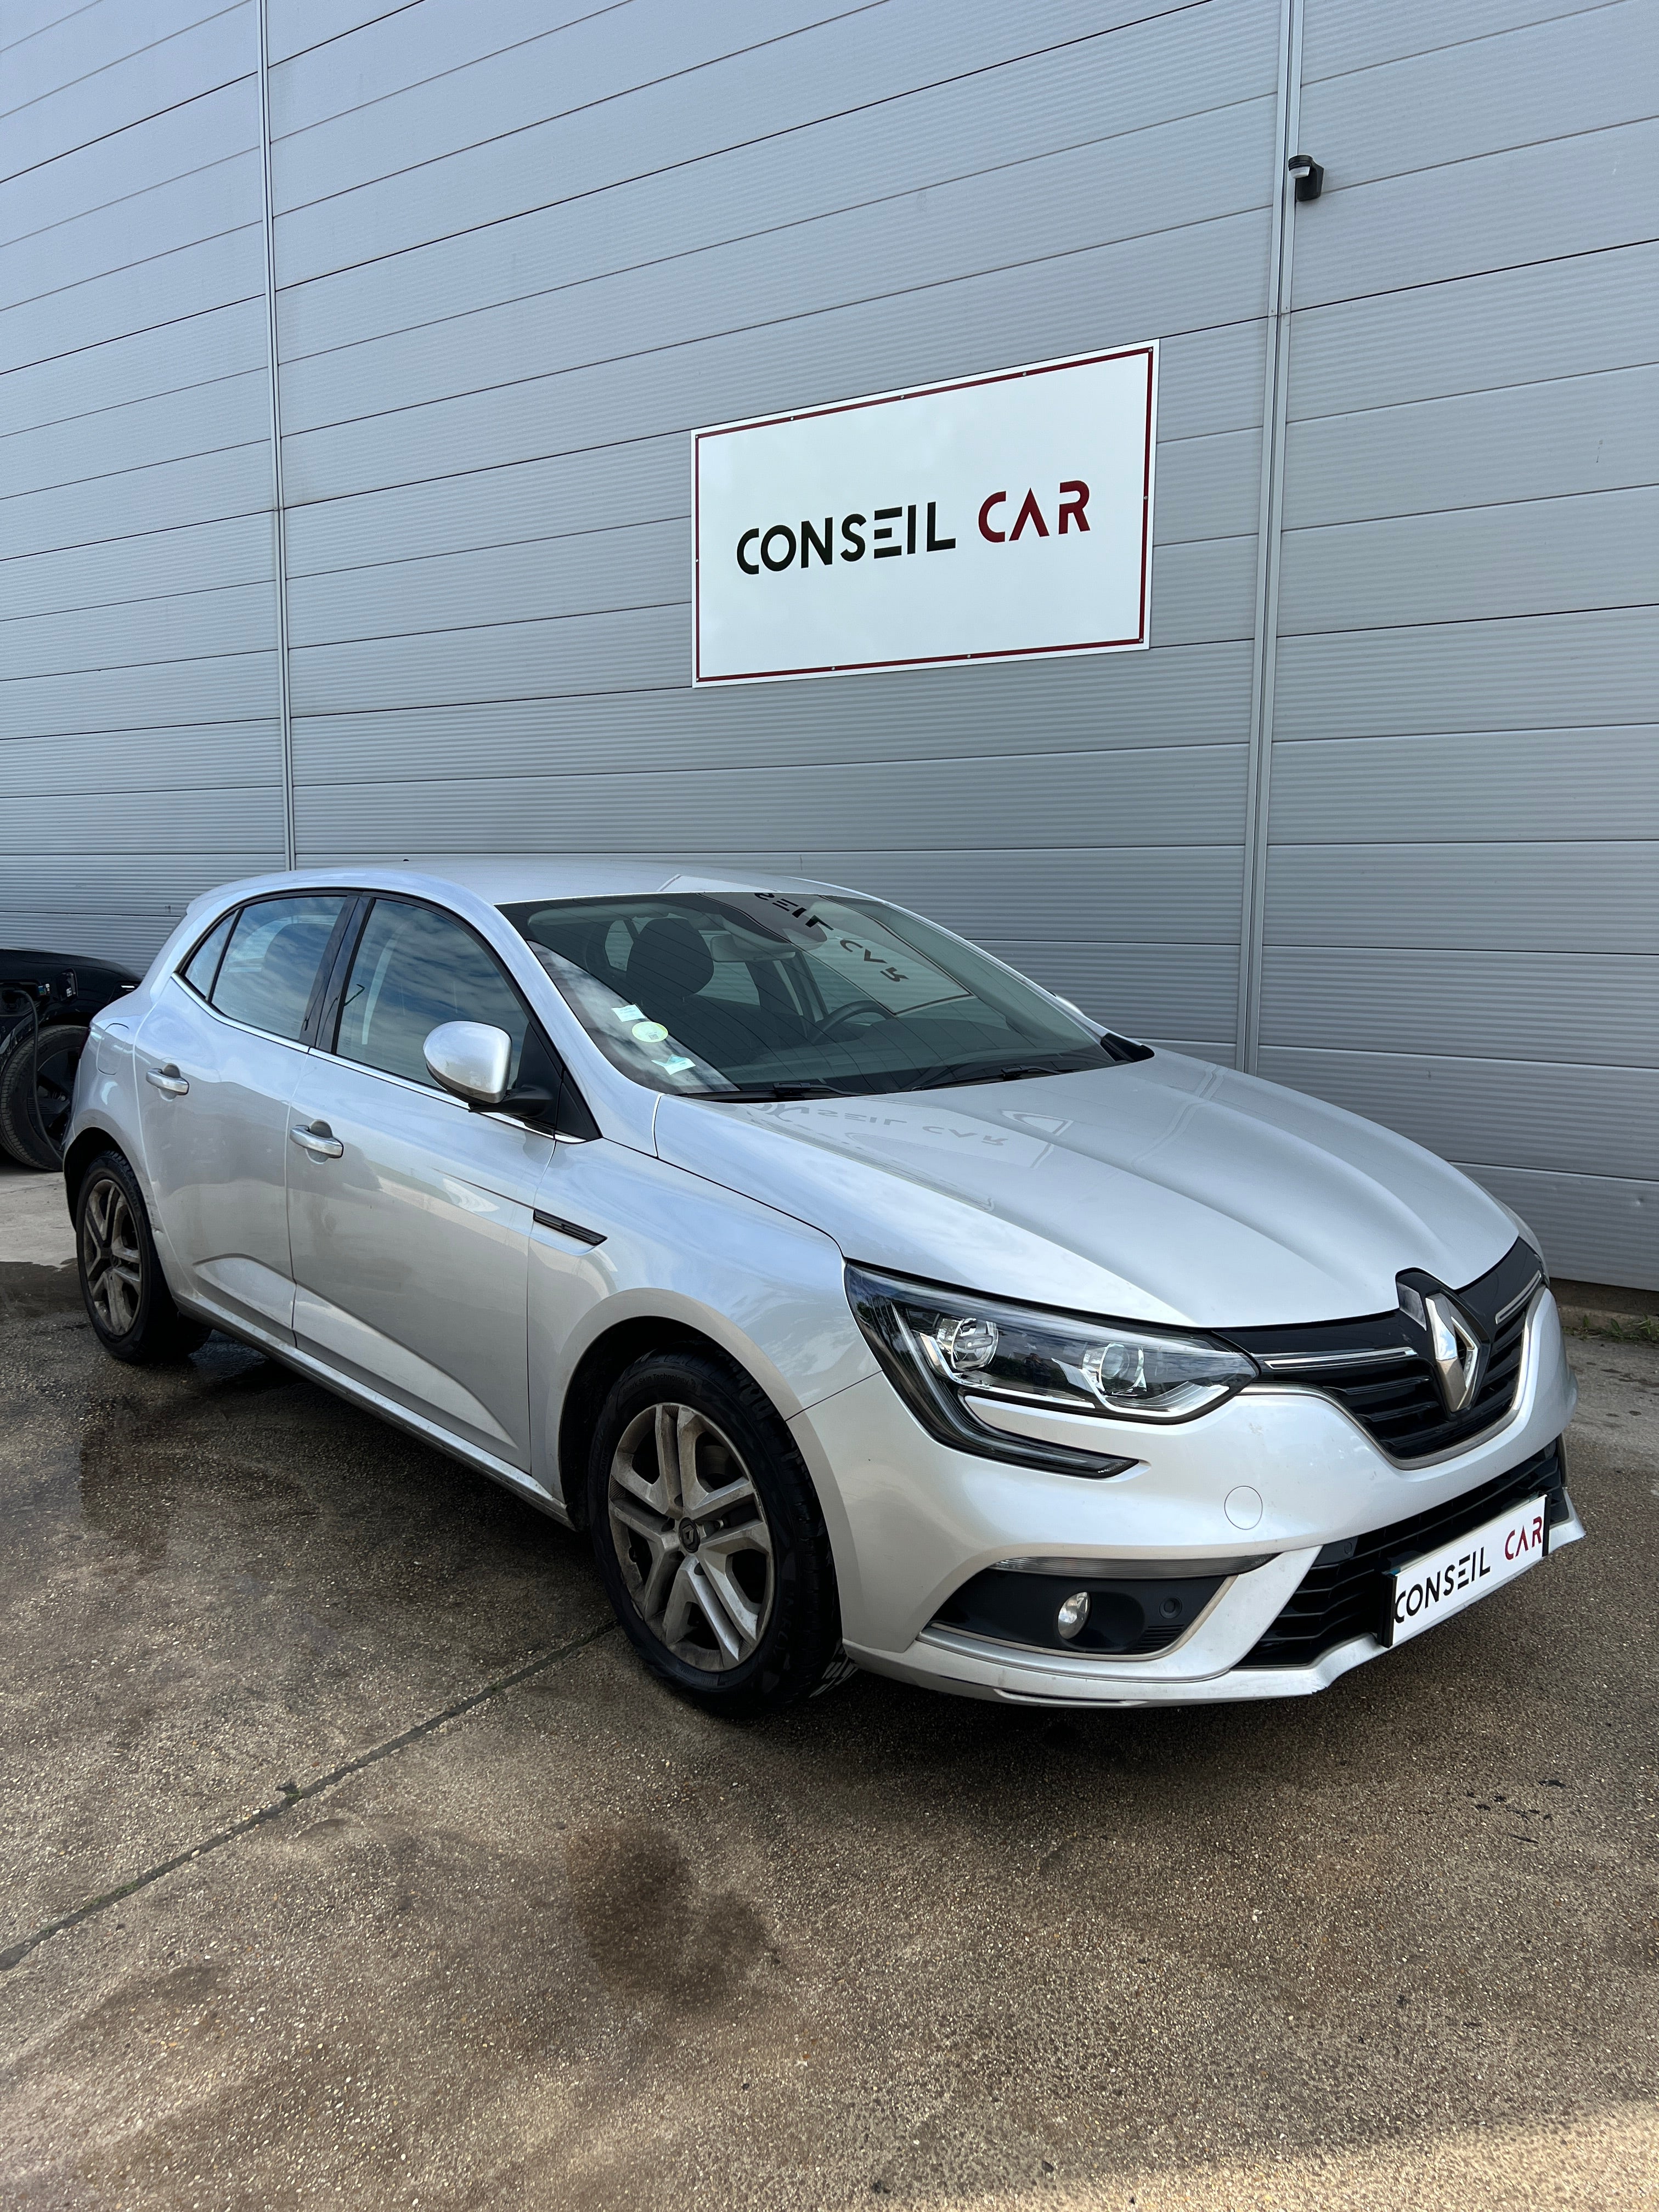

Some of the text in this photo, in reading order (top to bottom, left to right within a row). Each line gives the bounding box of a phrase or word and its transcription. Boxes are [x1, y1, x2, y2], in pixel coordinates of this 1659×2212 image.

[736, 479, 1091, 575] CONSEIL CAR
[1394, 1516, 1543, 1624] CONSEIL CAR
